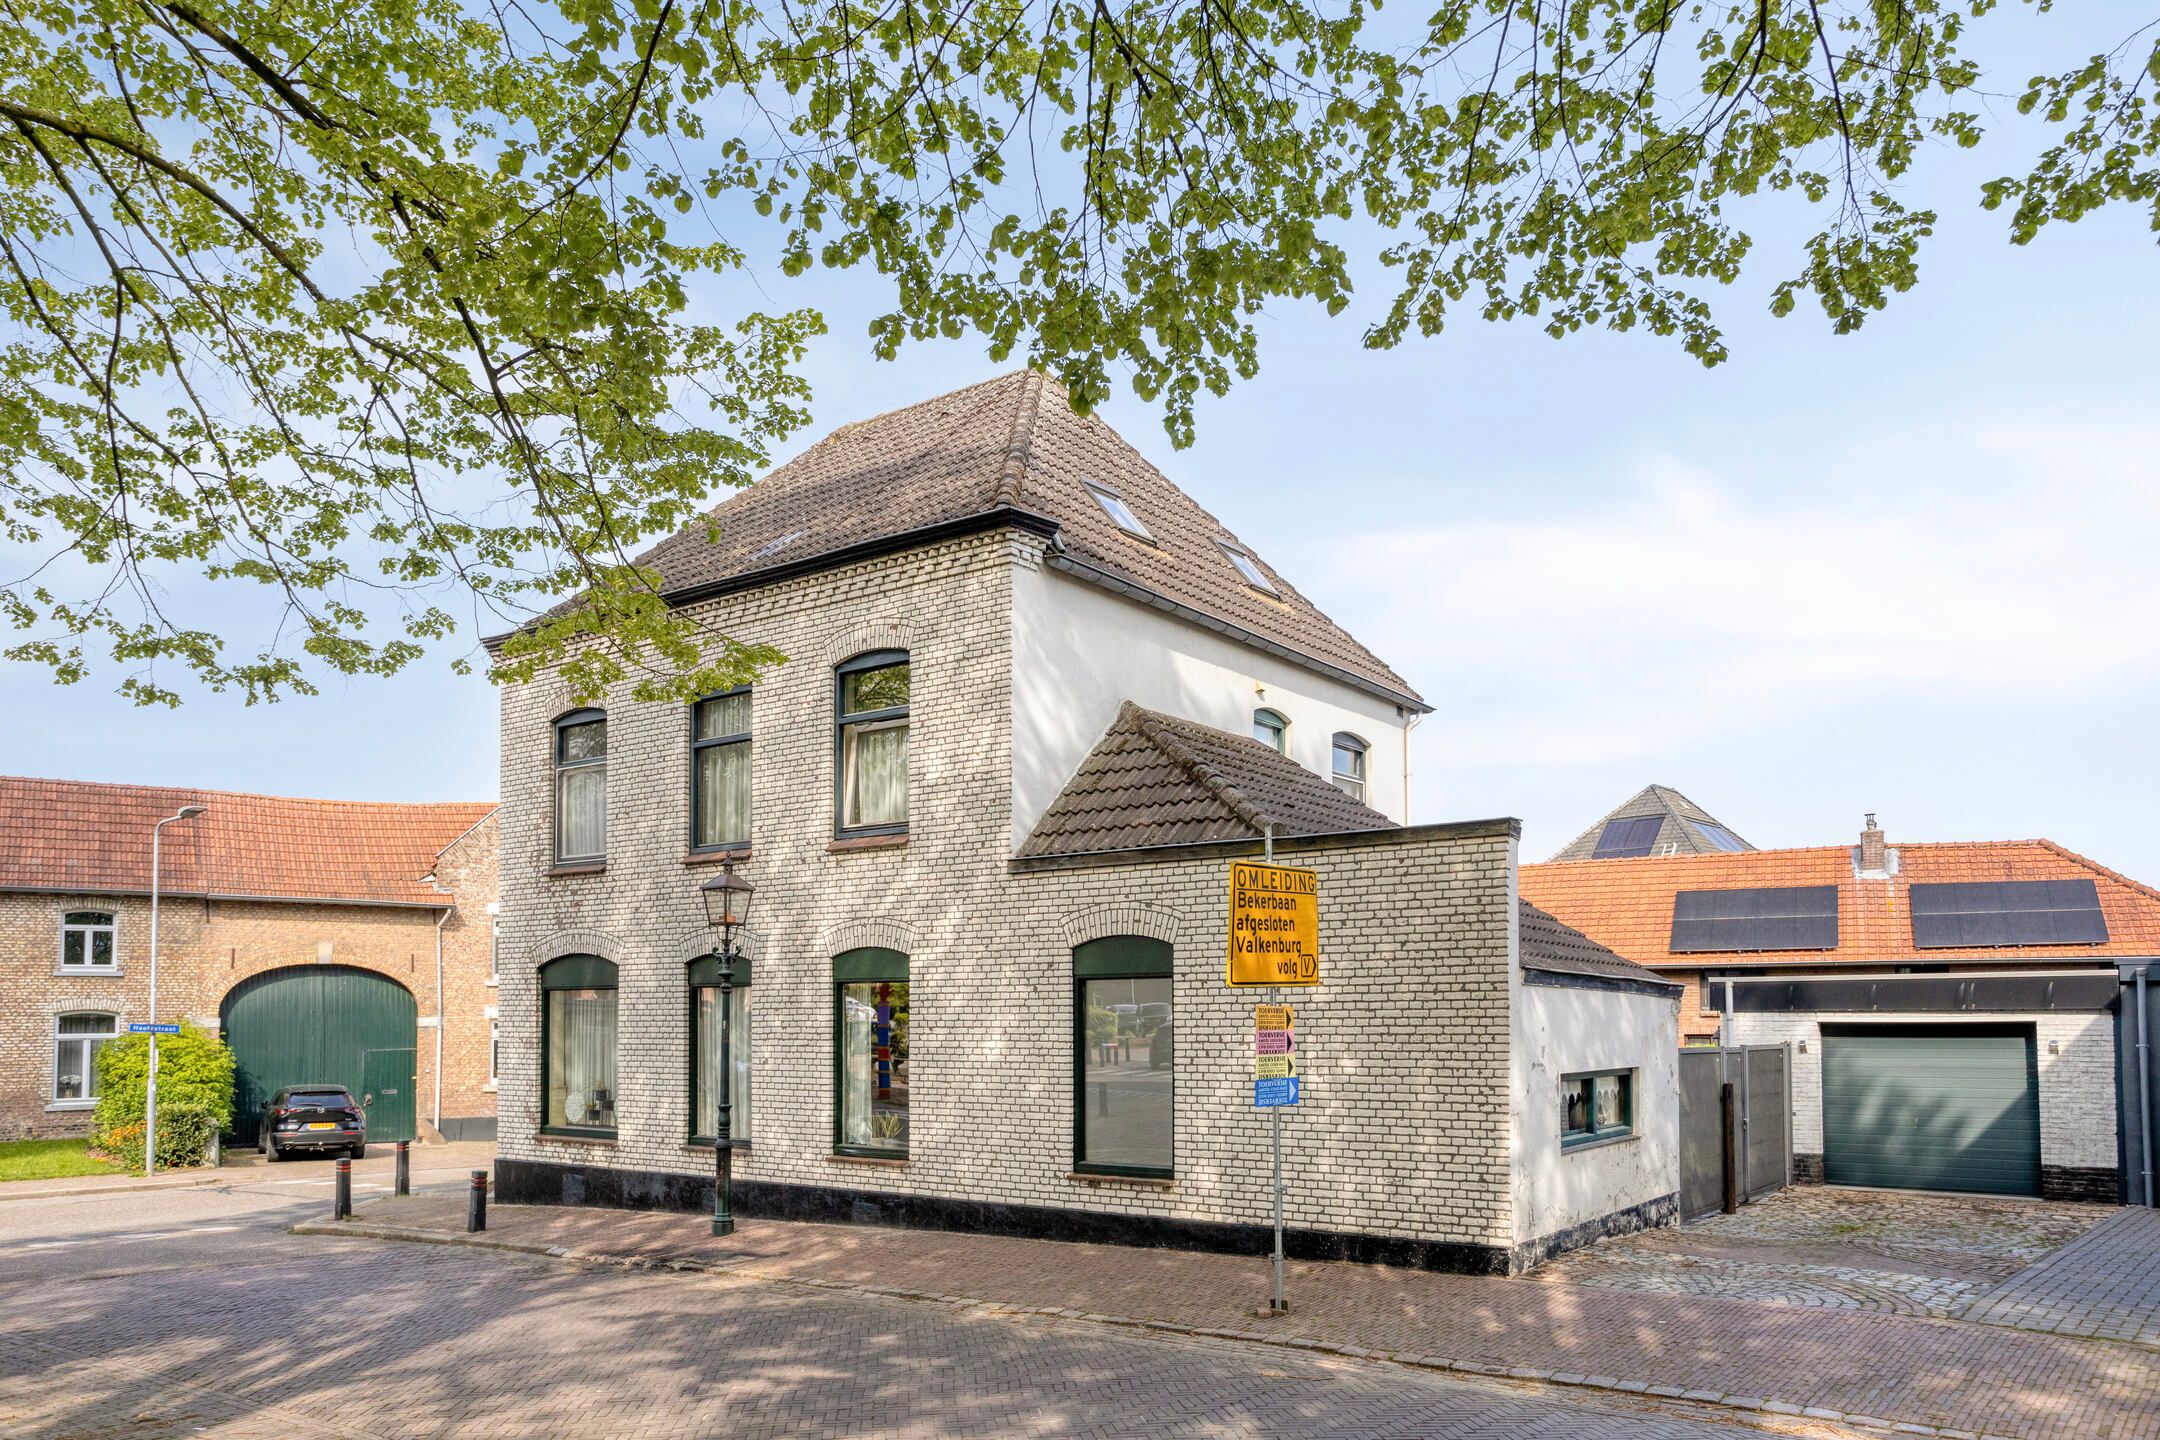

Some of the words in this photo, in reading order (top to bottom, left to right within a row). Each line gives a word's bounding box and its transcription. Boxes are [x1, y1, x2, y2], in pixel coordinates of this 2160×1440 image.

[1237, 869, 1315, 892] OMLEIDING
[1238, 891, 1297, 911] Bekerbaan
[1236, 914, 1295, 936] afgesloten
[1236, 935, 1302, 958] Valkenburg
[1277, 959, 1298, 979] volg
[1303, 958, 1311, 974] V
